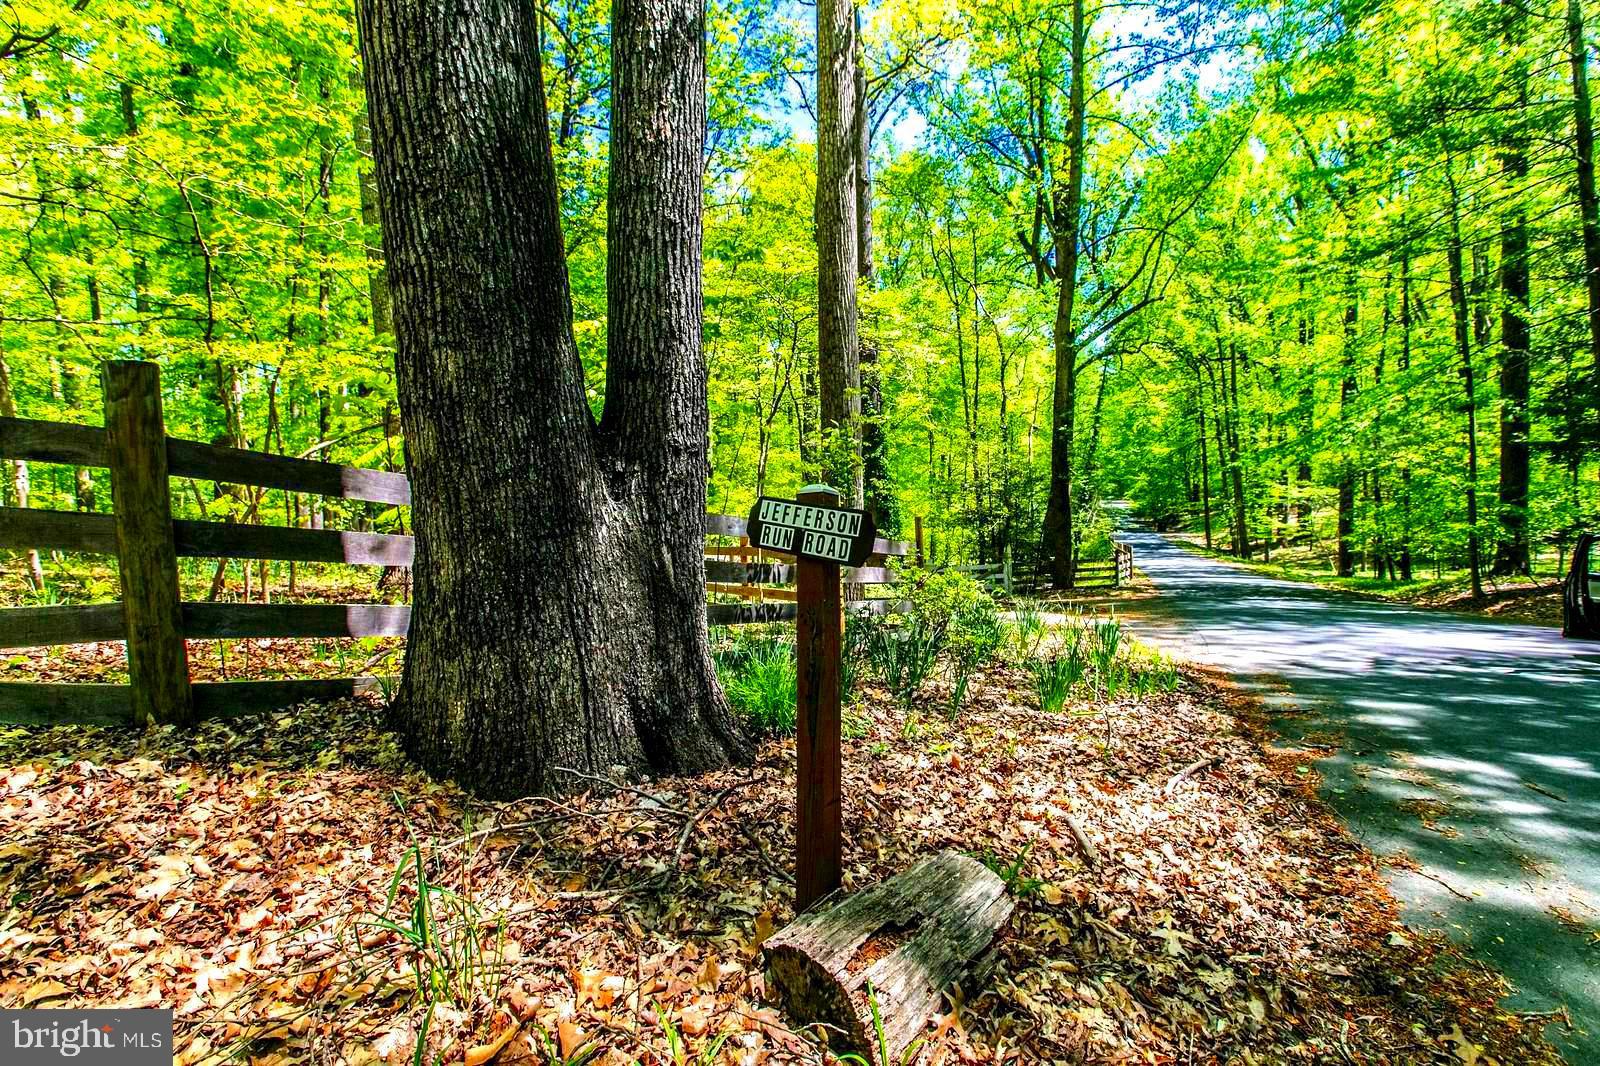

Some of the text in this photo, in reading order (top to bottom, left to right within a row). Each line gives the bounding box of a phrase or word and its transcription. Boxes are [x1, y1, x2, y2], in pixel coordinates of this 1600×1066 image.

[761, 501, 861, 535] JEFFERSON
[761, 525, 850, 559] RUN ROAD
